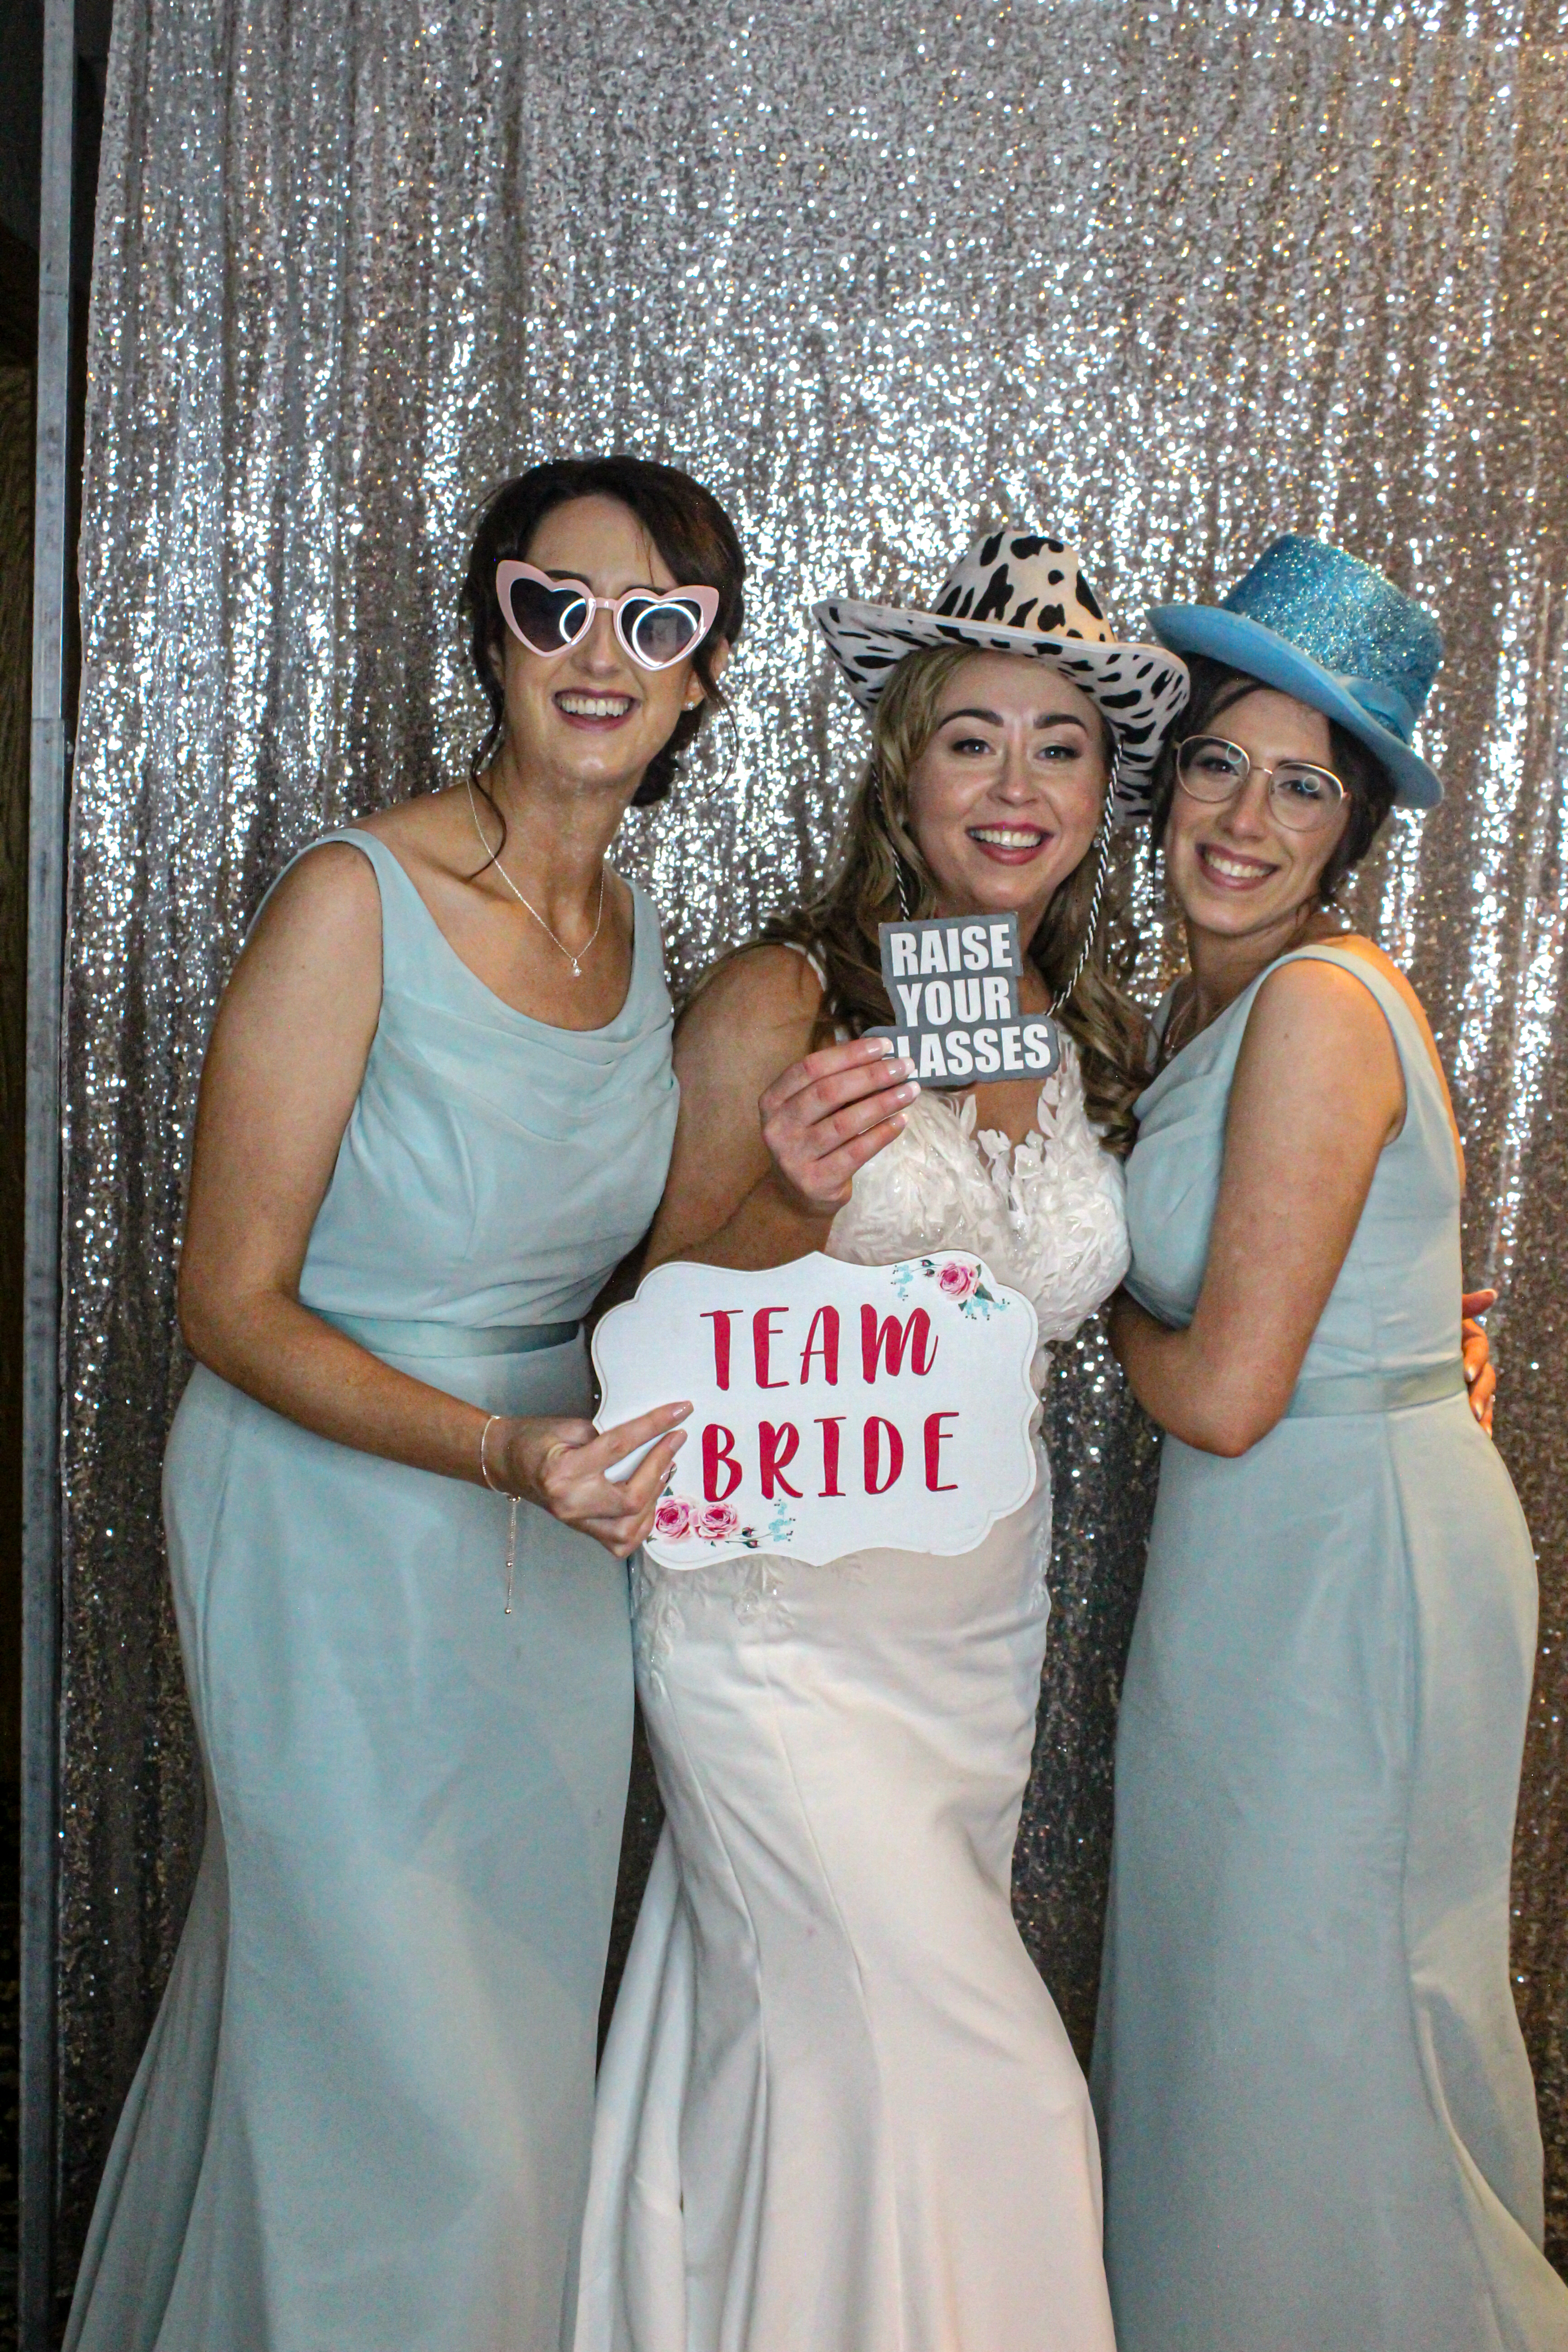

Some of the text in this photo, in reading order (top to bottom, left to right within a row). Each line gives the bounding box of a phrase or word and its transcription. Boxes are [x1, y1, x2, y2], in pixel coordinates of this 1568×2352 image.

[890, 924, 1013, 977] RAISE
[897, 976, 1012, 1027] YOUR
[882, 1024, 1051, 1079] LASSES
[700, 1303, 939, 1391] TEAM
[701, 1412, 960, 1503] BRIDE
